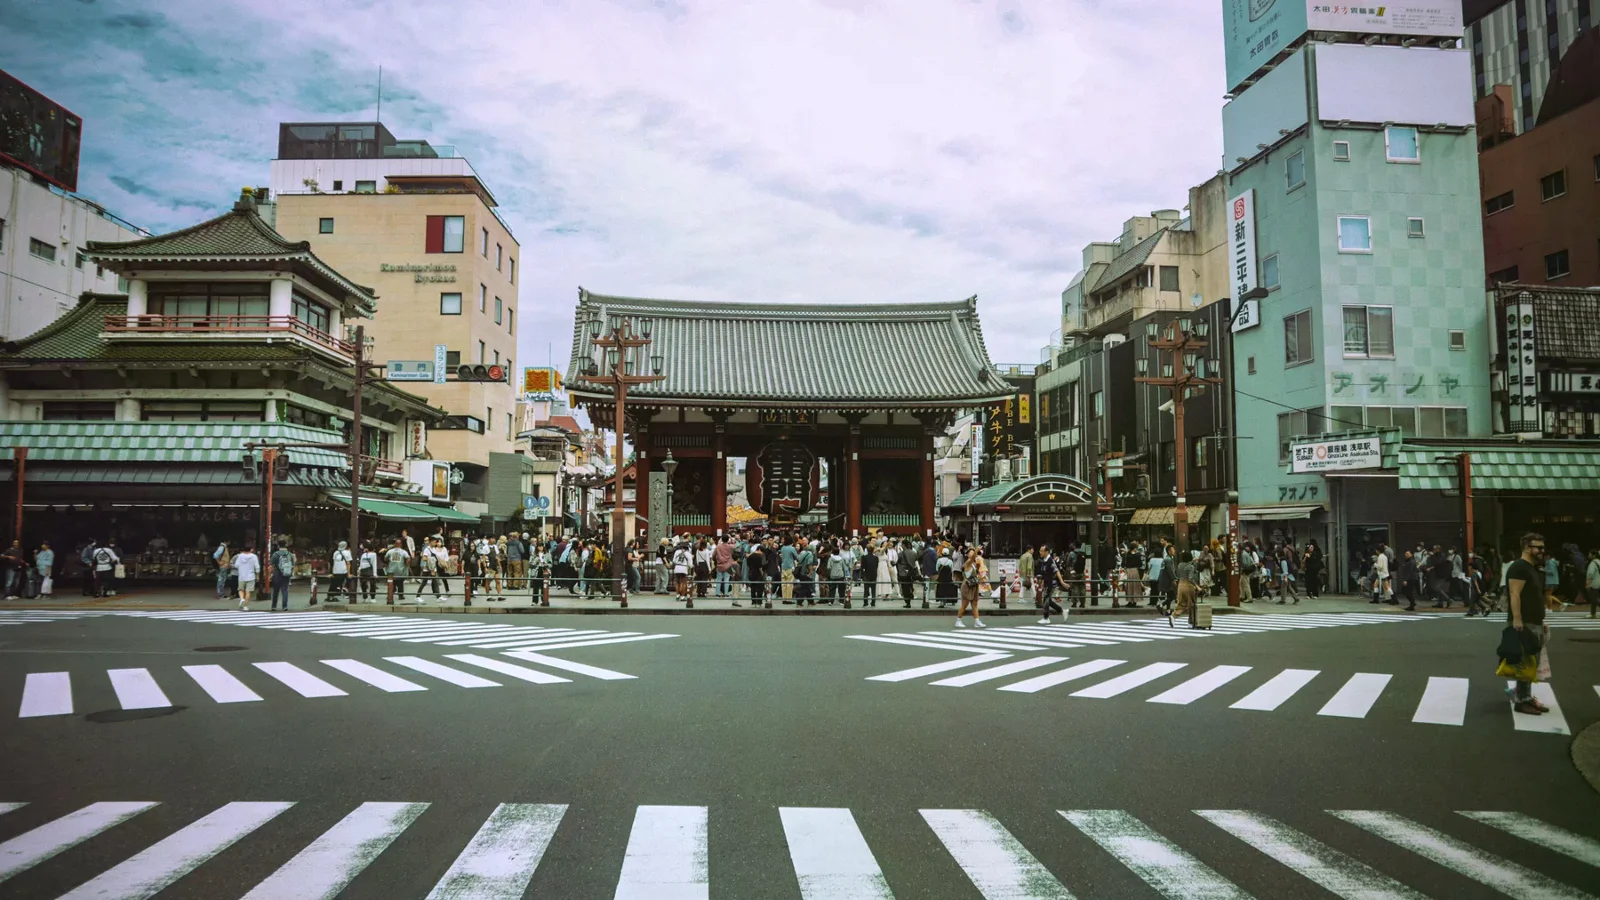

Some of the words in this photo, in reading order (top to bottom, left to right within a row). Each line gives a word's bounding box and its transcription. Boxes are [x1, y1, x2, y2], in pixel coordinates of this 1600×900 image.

[380, 262, 457, 273] Kaminarimon
[414, 273, 457, 284] Ryokan
[394, 363, 426, 372] 雷門
[1333, 373, 1459, 395] アオノヤ
[1295, 447, 1314, 456] 地下鉄
[1327, 444, 1348, 453] 銀座線
[1350, 442, 1371, 451] 浅草駅
[757, 443, 815, 514] 雷門
[1279, 484, 1318, 501] アオノヤ
